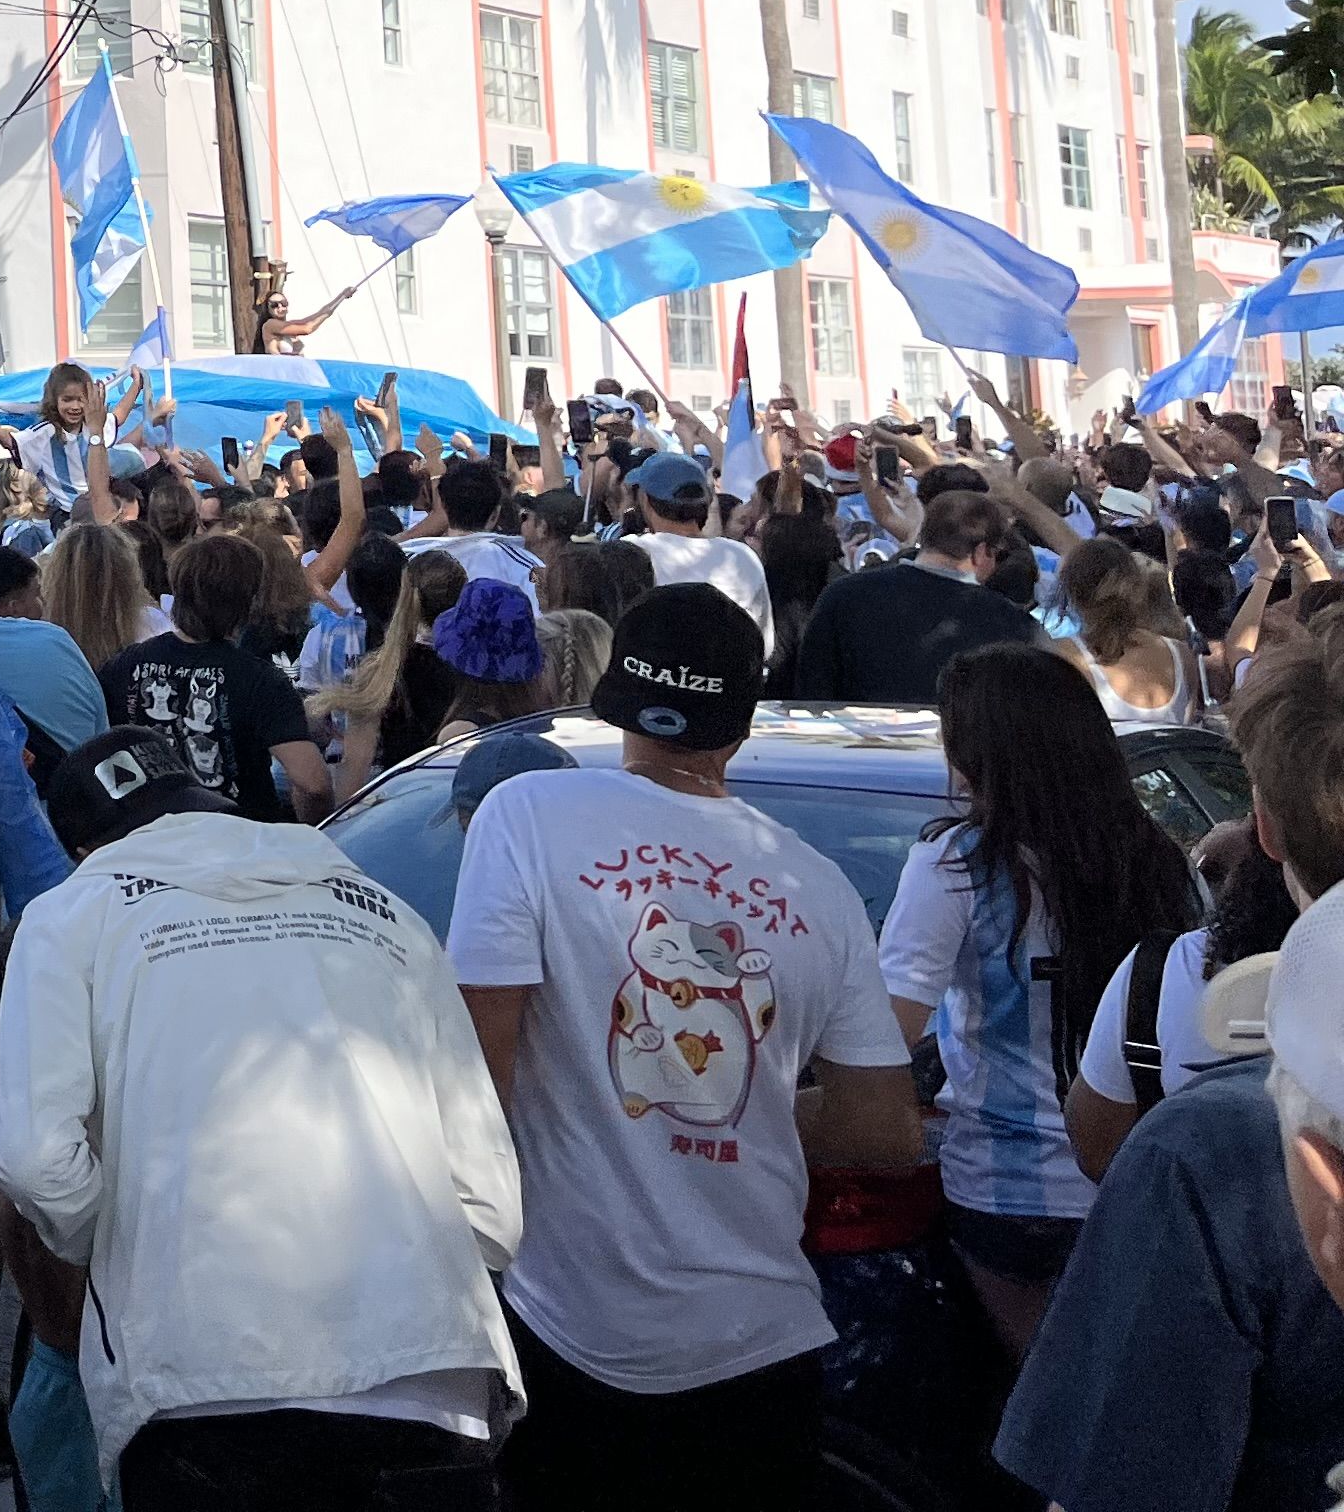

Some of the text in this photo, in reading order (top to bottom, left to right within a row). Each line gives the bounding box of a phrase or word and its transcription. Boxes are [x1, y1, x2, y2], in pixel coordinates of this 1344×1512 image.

[579, 844, 810, 937] LUCKY CAT
[152, 919, 196, 936] FORMULA
